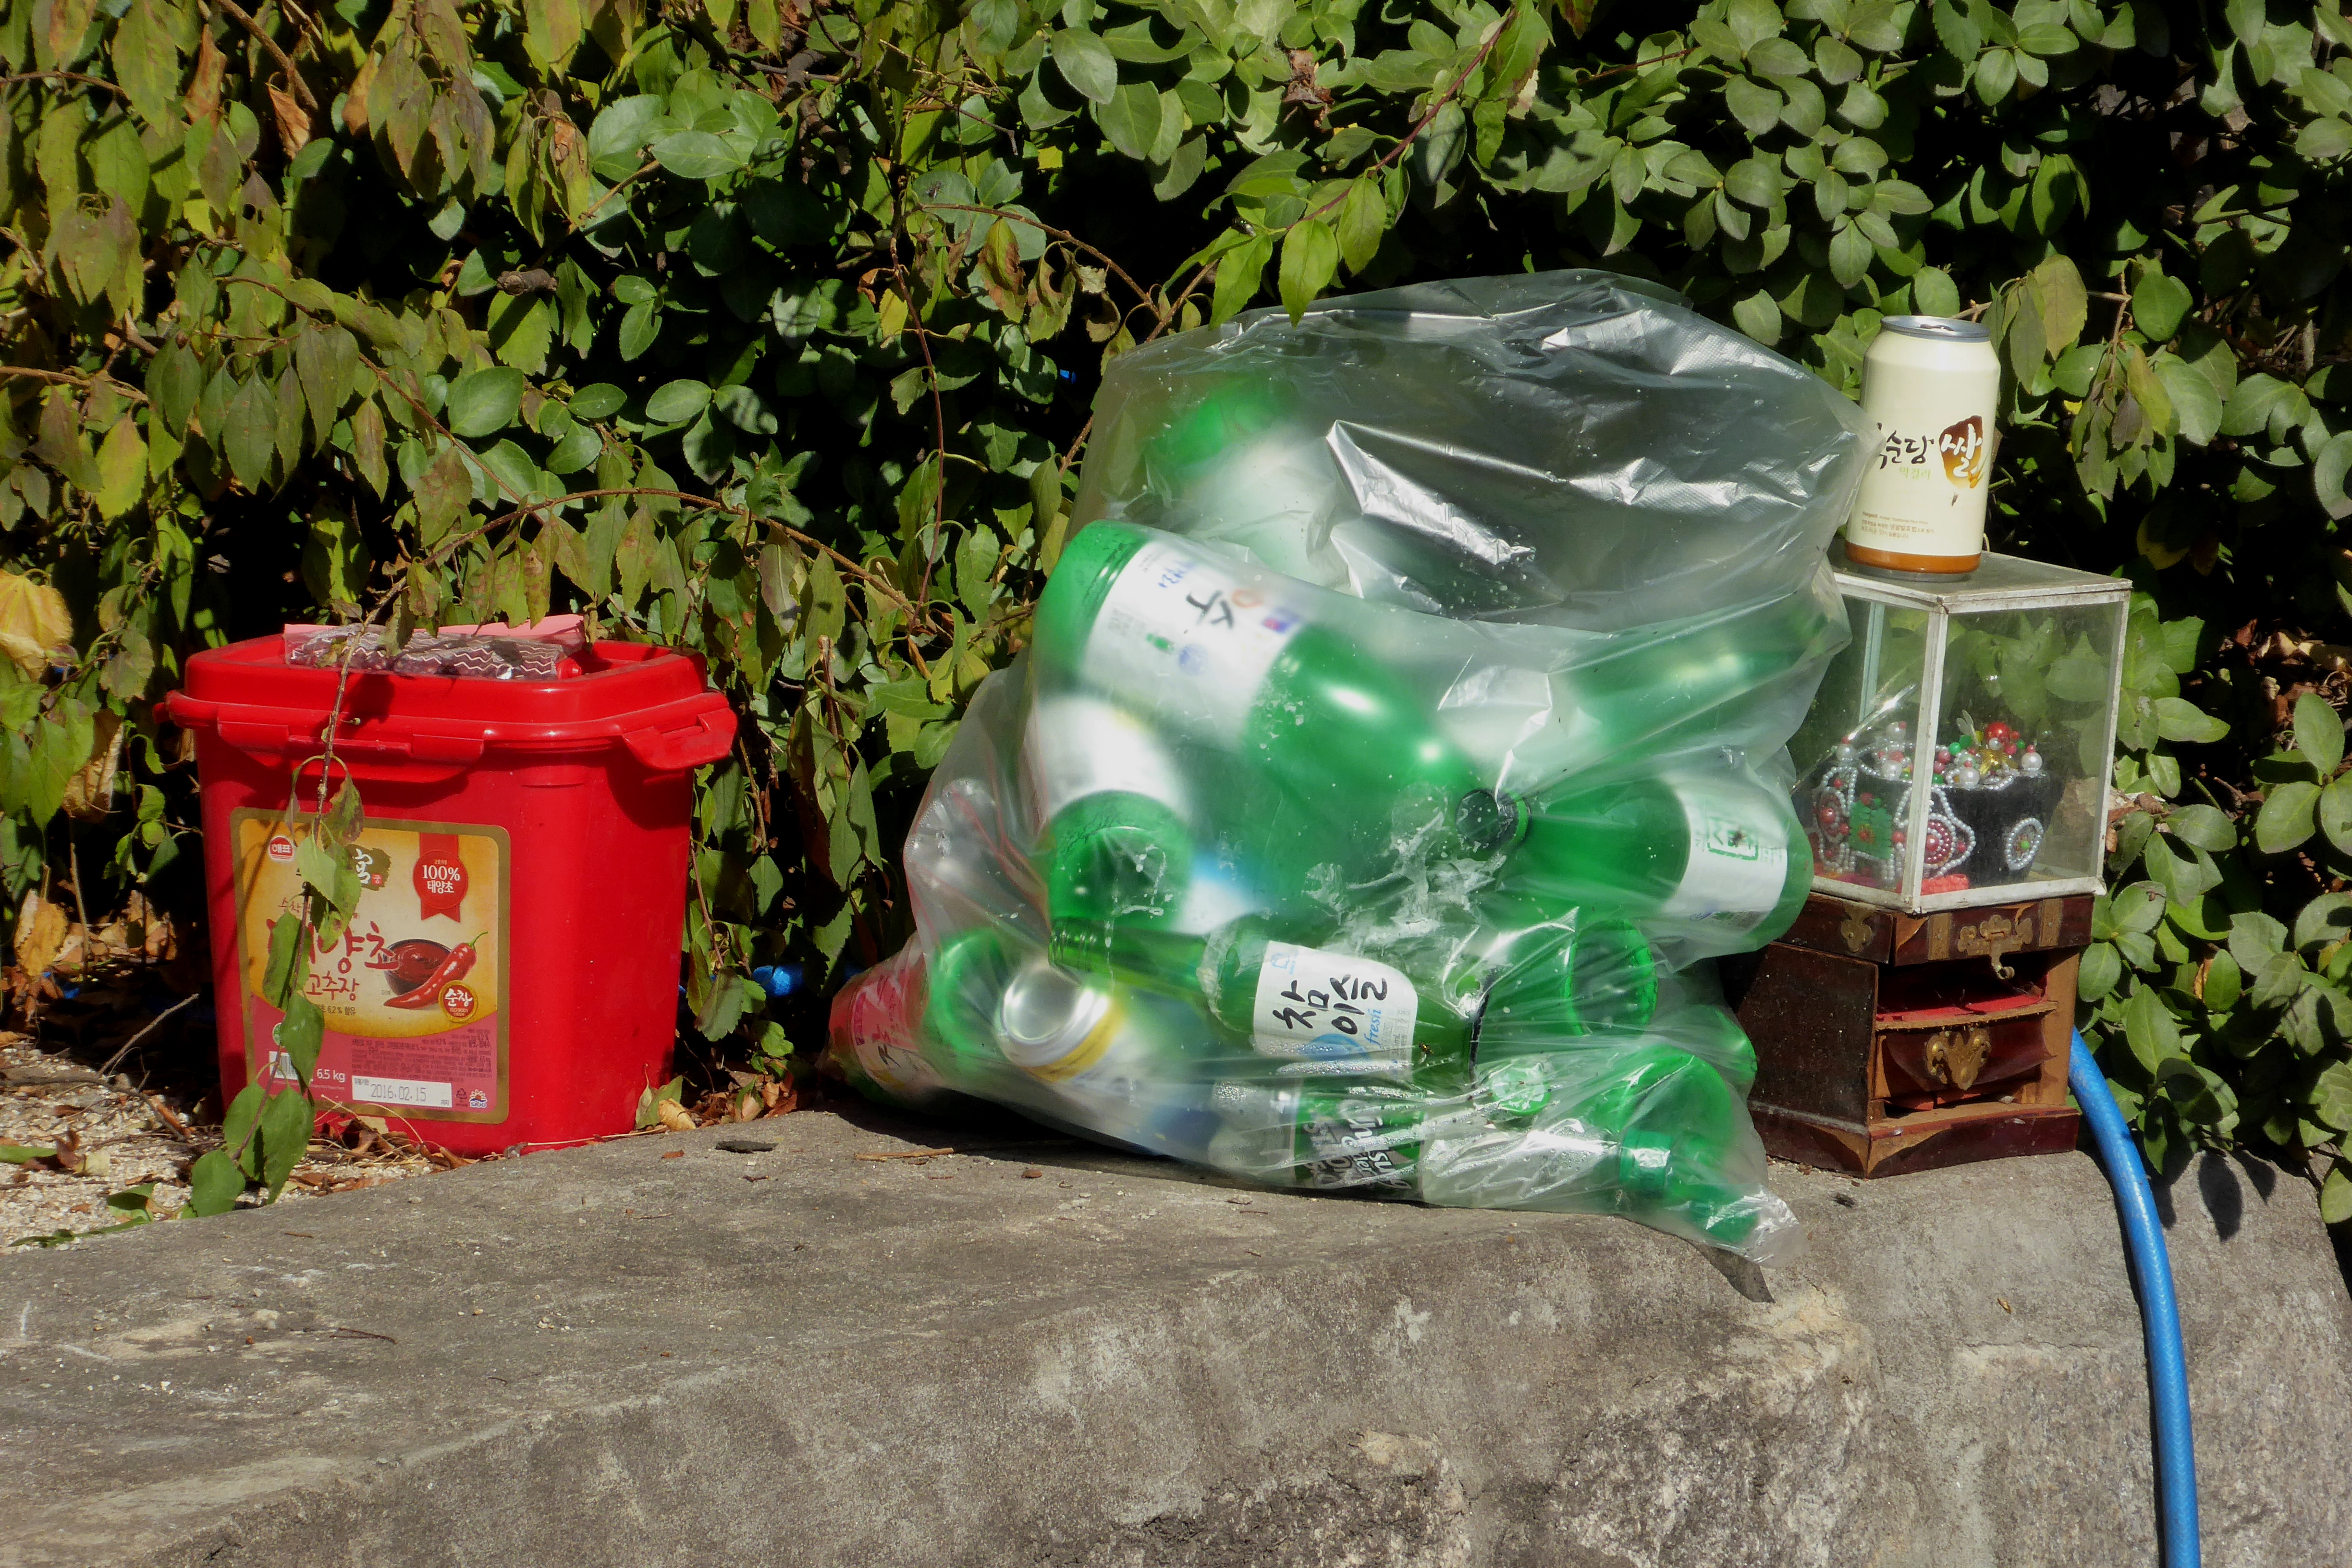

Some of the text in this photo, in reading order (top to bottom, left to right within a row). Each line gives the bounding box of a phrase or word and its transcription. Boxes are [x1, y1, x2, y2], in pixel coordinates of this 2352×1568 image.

[1941, 423, 1983, 478] 쌀
[1900, 466, 1930, 479] 막걸리
[271, 844, 291, 854] 해표
[373, 875, 381, 884] 궁
[423, 865, 460, 881] 100%
[427, 880, 454, 894] 태양초
[267, 919, 399, 974] 양초
[306, 970, 360, 1001] 고추장
[445, 988, 473, 1007] 순창
[1364, 1009, 1383, 1050] fresh
[333, 1070, 345, 1082] kg
[370, 1083, 427, 1102] 2016.02.15
